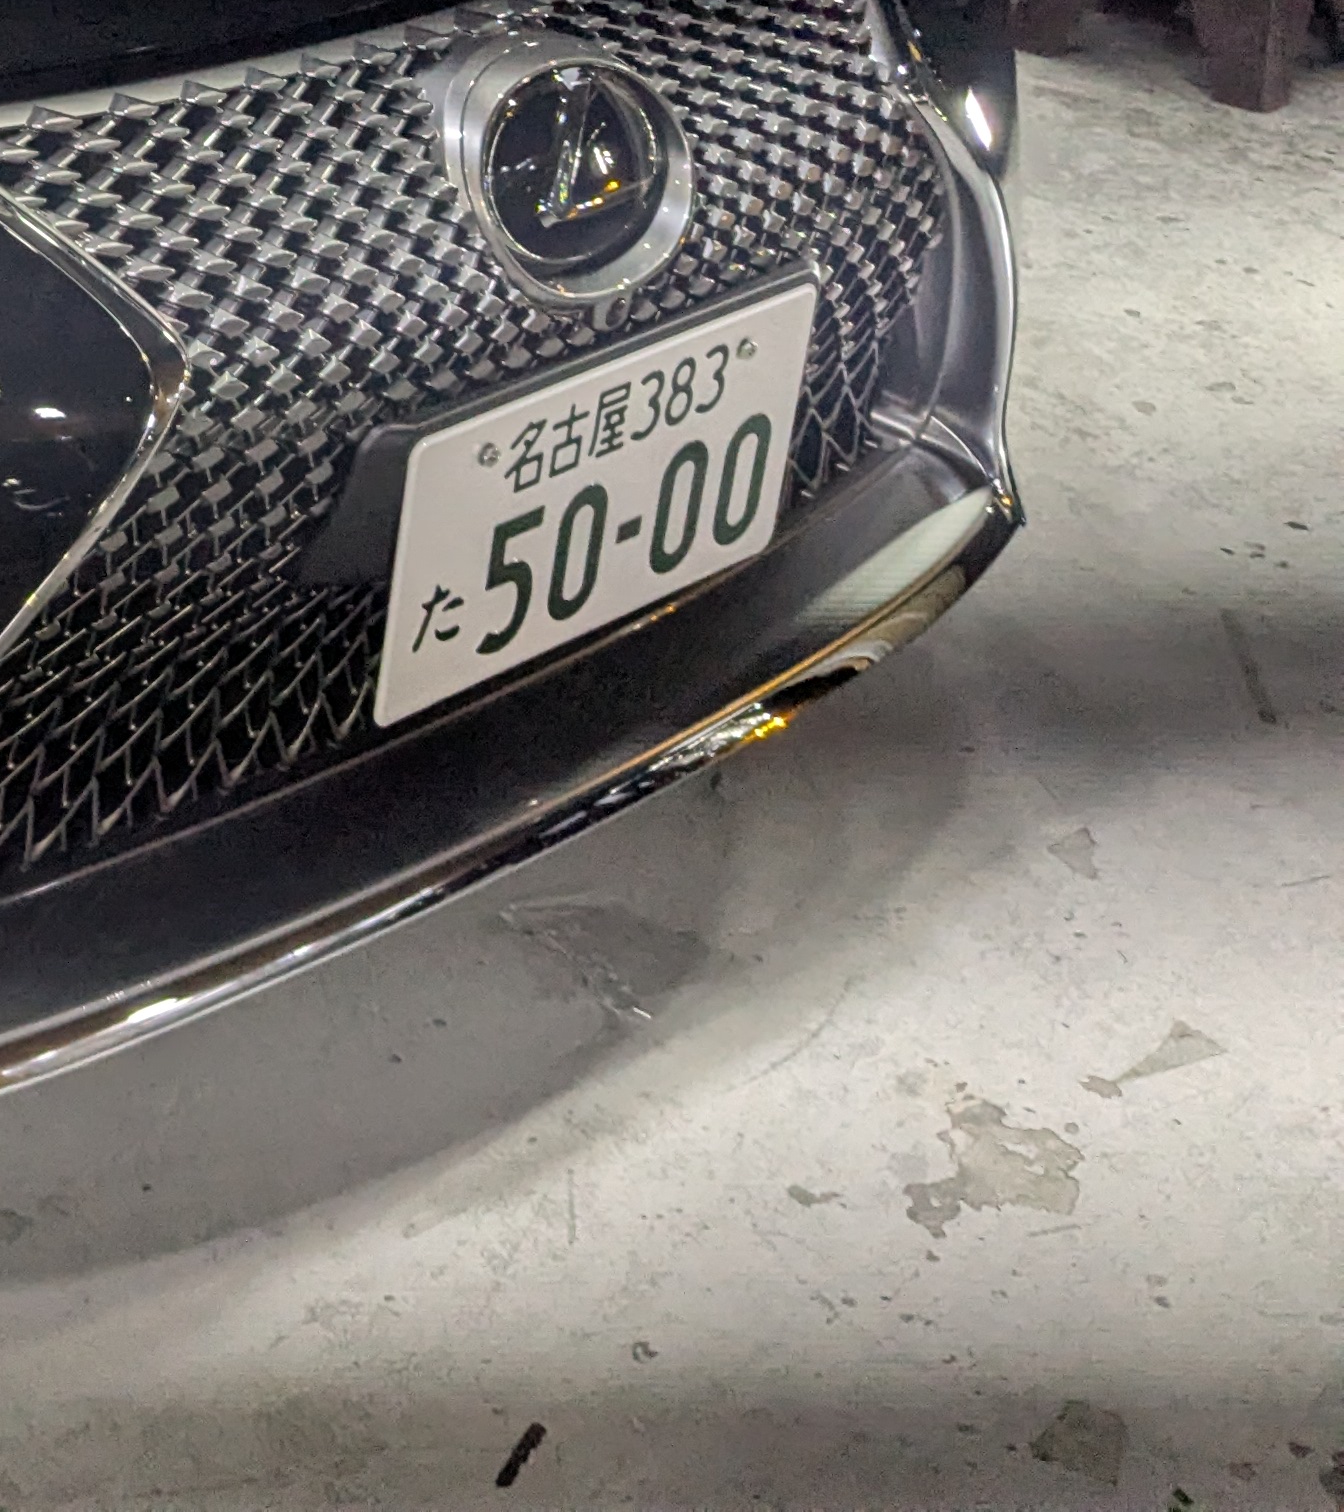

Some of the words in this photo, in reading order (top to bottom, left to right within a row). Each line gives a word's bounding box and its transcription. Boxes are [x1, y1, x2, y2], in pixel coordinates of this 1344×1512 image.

[504, 381, 632, 494] 名古屋
[629, 343, 730, 441] 383
[411, 584, 466, 654] た
[475, 412, 773, 656] 50-00
